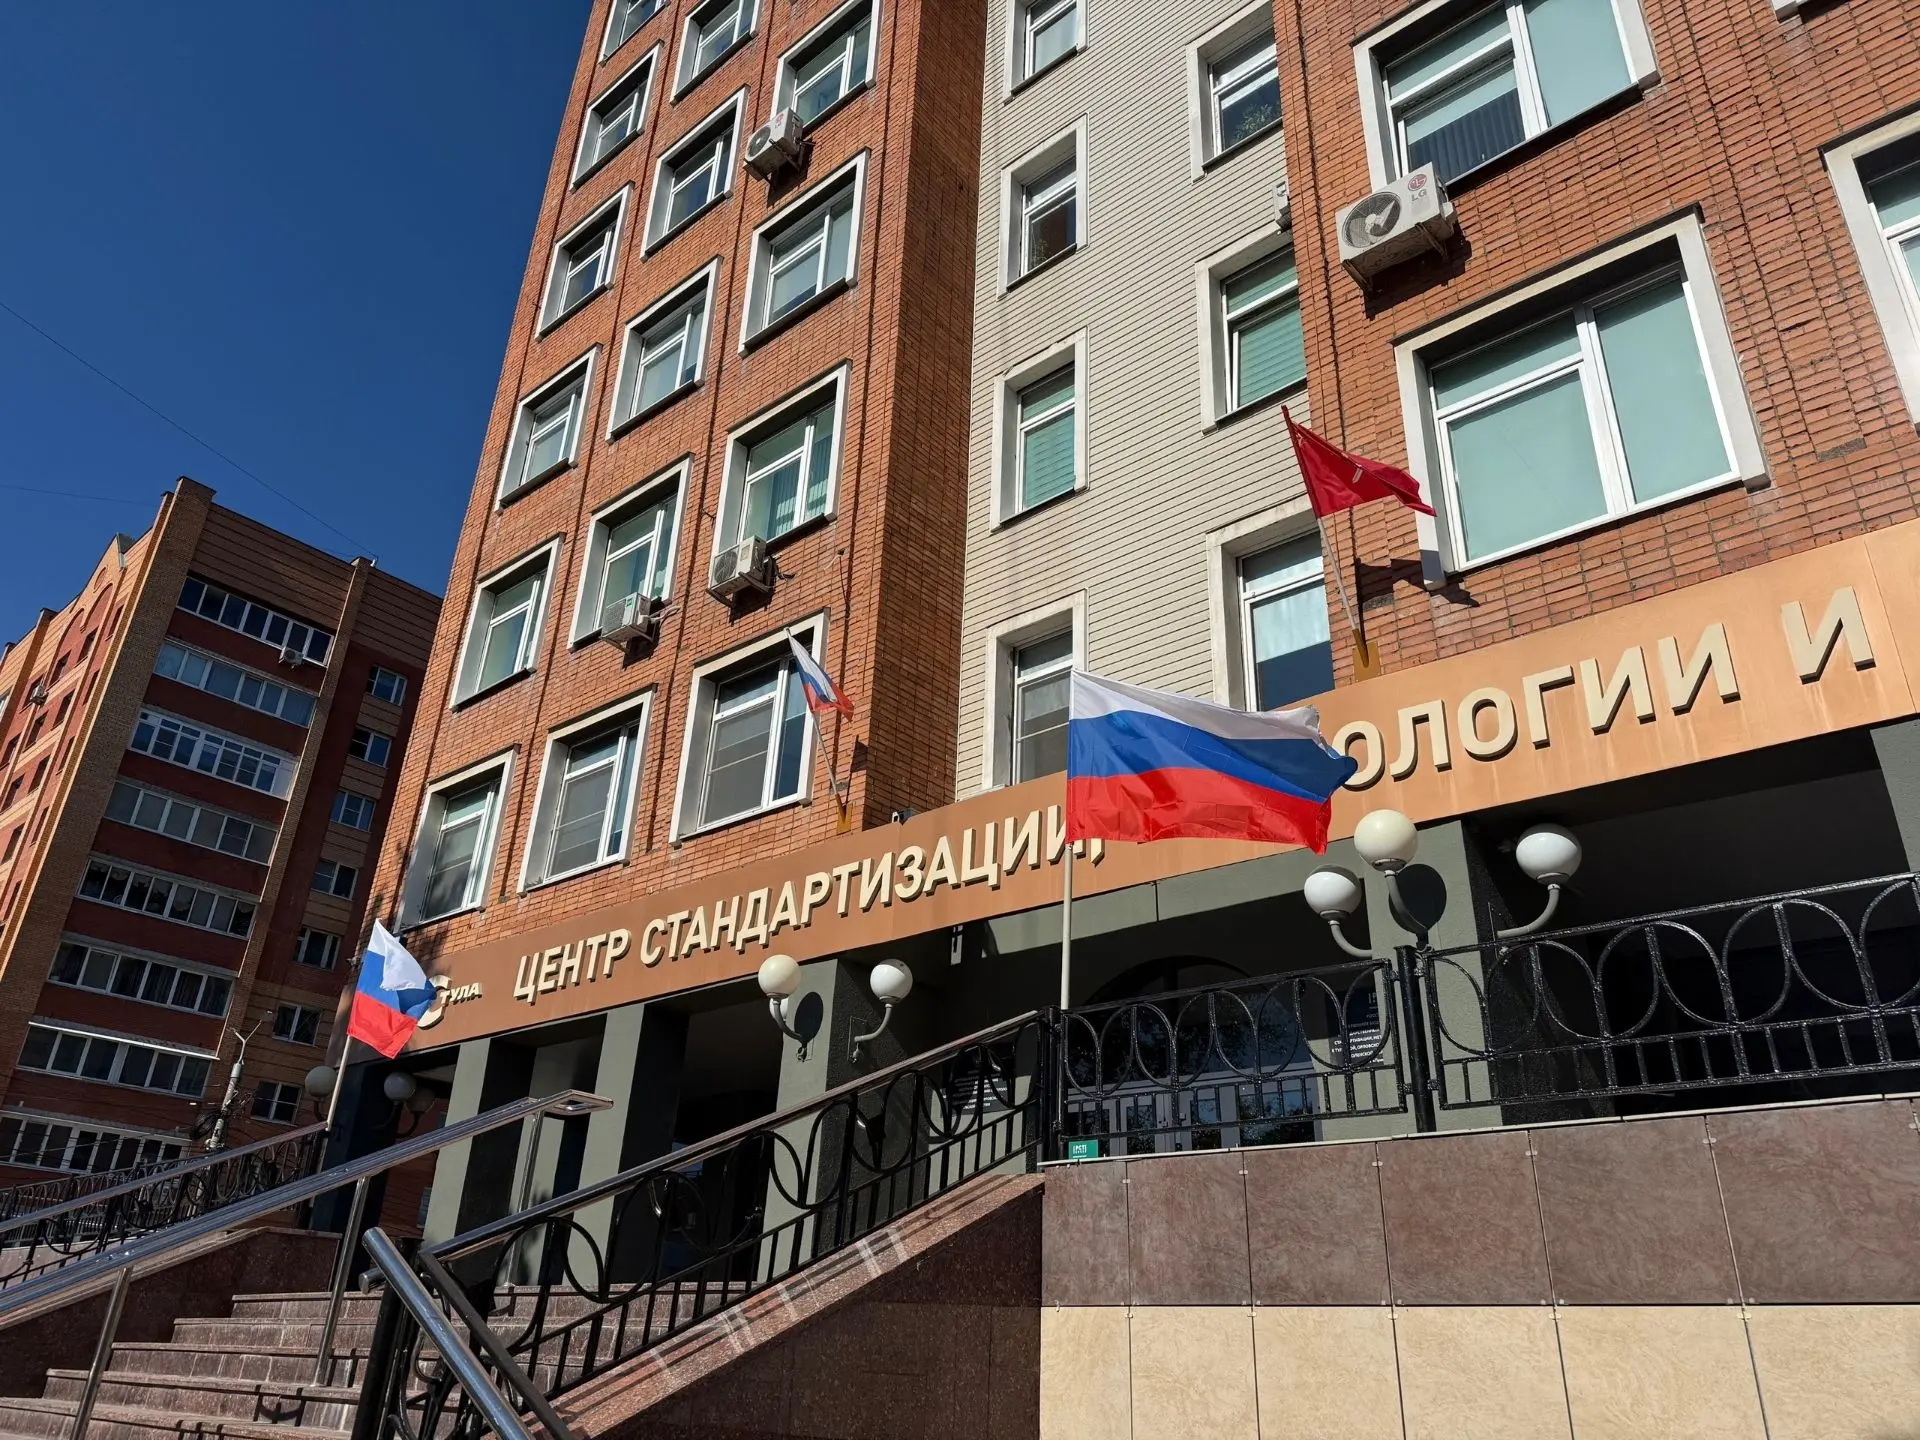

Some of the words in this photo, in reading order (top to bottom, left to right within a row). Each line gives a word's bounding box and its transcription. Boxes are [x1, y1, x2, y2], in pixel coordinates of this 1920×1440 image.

[1411, 189, 1427, 201] LG
[513, 928, 631, 1006] ЦЕНТР
[1332, 622, 1741, 792] ОЛОГИИ
[1780, 586, 1877, 685] И
[440, 982, 483, 1007] ТУЛА
